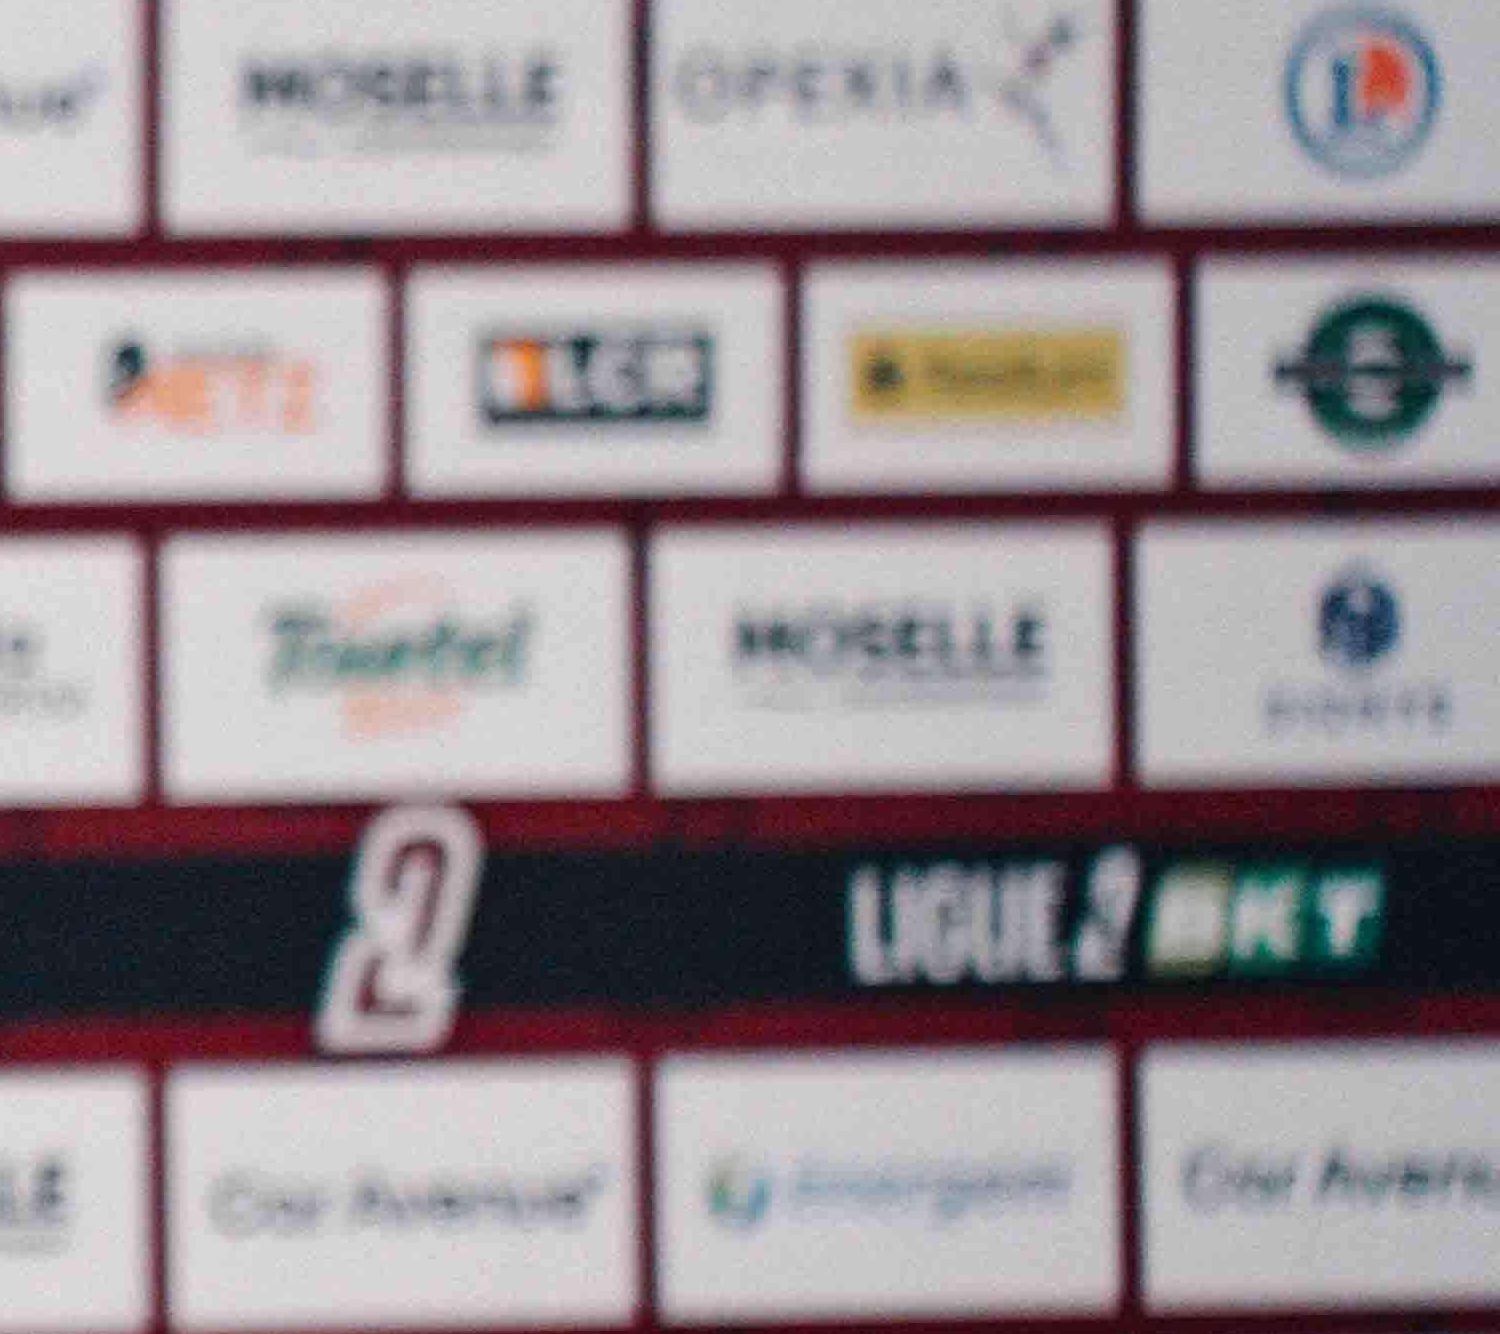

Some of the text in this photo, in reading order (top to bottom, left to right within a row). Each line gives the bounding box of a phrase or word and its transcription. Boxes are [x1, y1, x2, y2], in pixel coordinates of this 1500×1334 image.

[244, 60, 555, 117] MOSELLE
[678, 51, 968, 110] OPEXIA
[737, 611, 1042, 671] MOSELLE
[852, 868, 1058, 982] LIGUE
